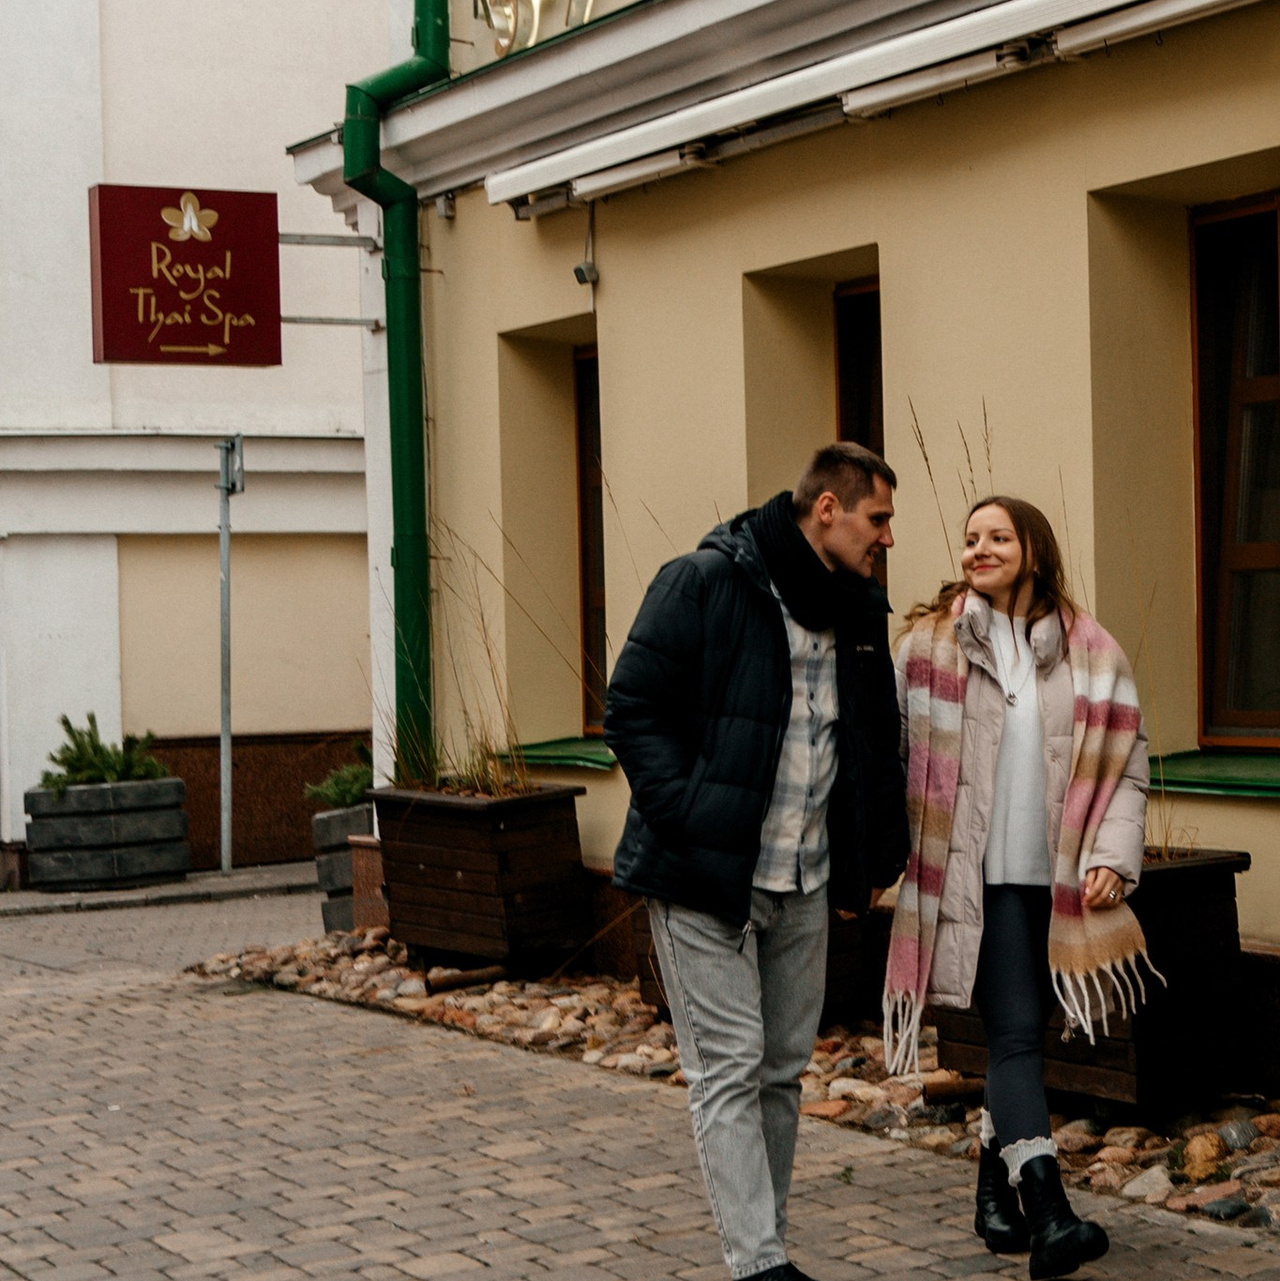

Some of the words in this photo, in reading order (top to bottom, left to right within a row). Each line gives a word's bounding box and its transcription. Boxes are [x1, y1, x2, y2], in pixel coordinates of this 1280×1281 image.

[151, 240, 231, 301] Royal
[129, 286, 192, 343] Thai
[200, 288, 256, 345] Spa
